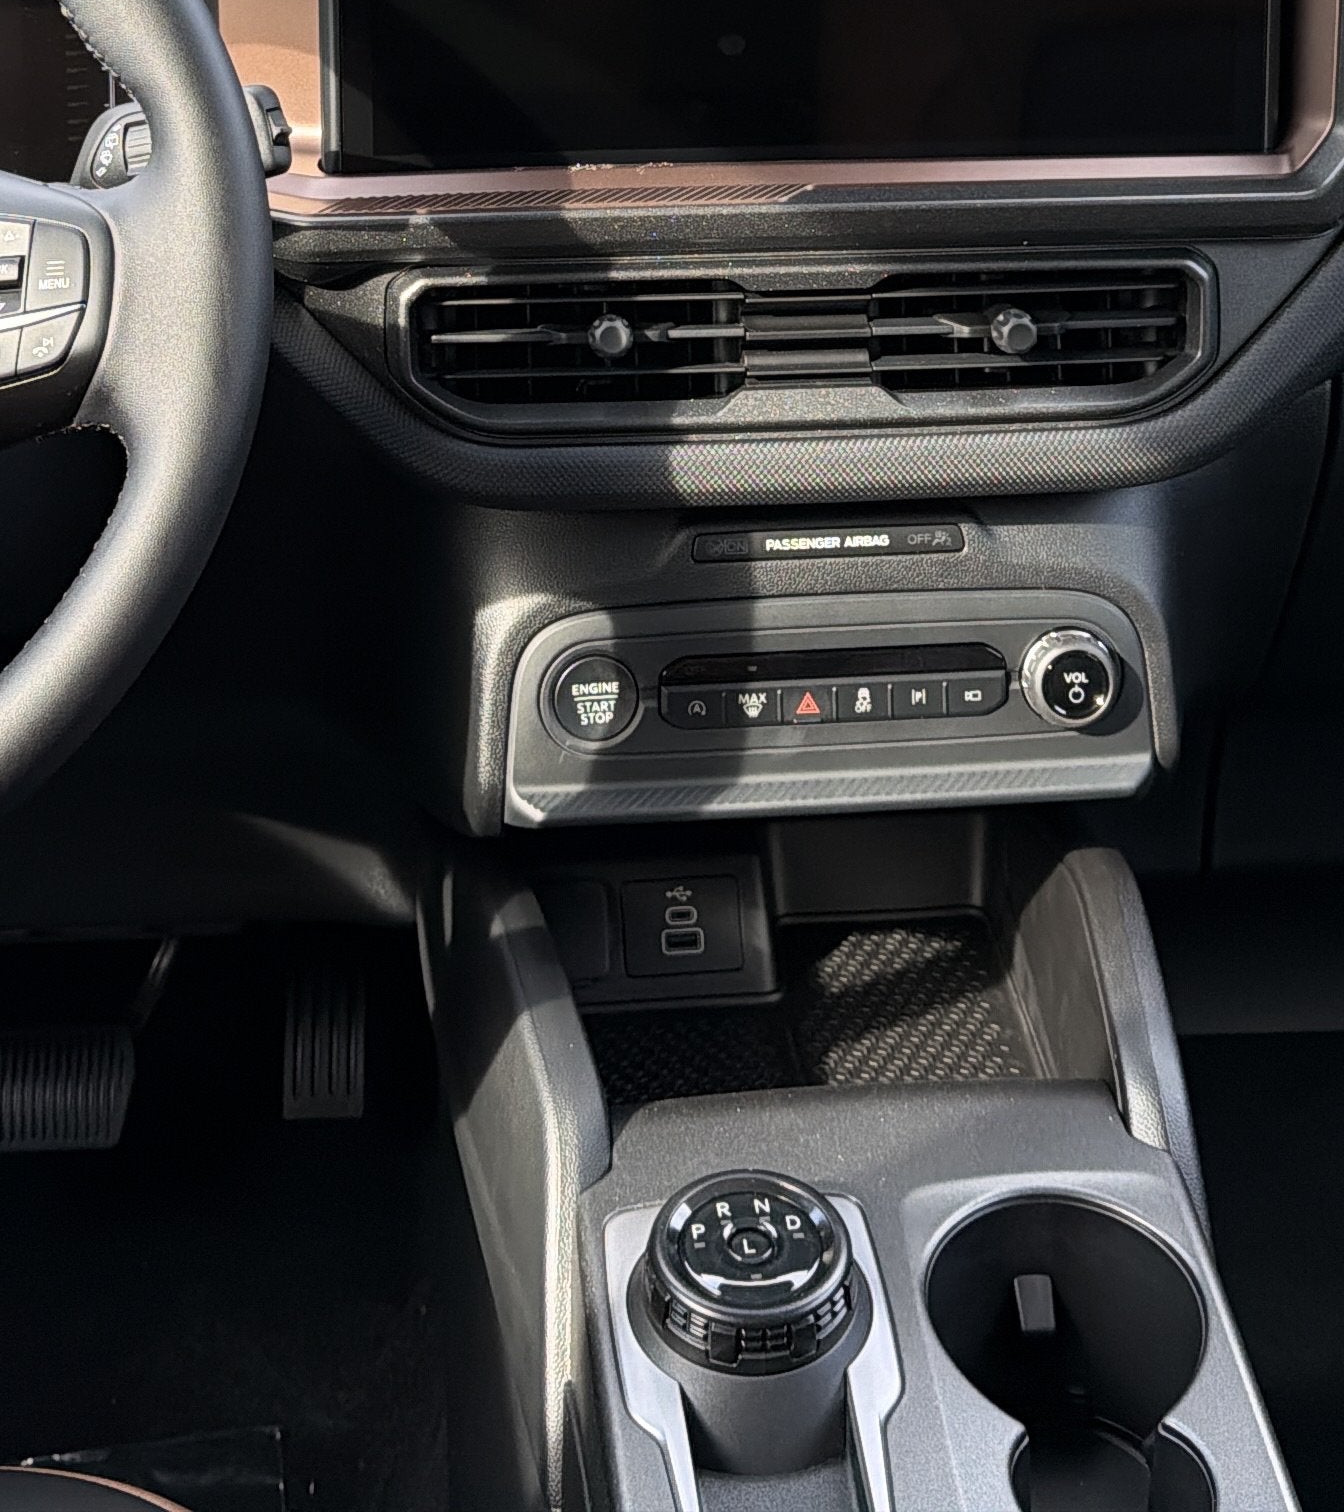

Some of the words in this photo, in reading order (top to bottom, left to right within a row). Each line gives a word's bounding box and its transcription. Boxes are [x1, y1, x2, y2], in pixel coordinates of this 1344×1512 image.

[38, 277, 71, 291] MENU
[765, 536, 841, 552] PASSENGER
[844, 534, 891, 549] AIRBAG
[907, 534, 933, 546] OFF
[1063, 672, 1090, 684] VOL
[571, 681, 620, 696] ENGINE
[738, 692, 768, 705] MAX
[576, 700, 617, 714] START
[854, 703, 873, 714] OFF
[580, 711, 614, 726] STOP
[716, 1201, 732, 1218] R
[753, 1197, 771, 1215] N
[785, 1214, 801, 1230] D
[691, 1223, 706, 1240] P
[742, 1238, 756, 1254] L
